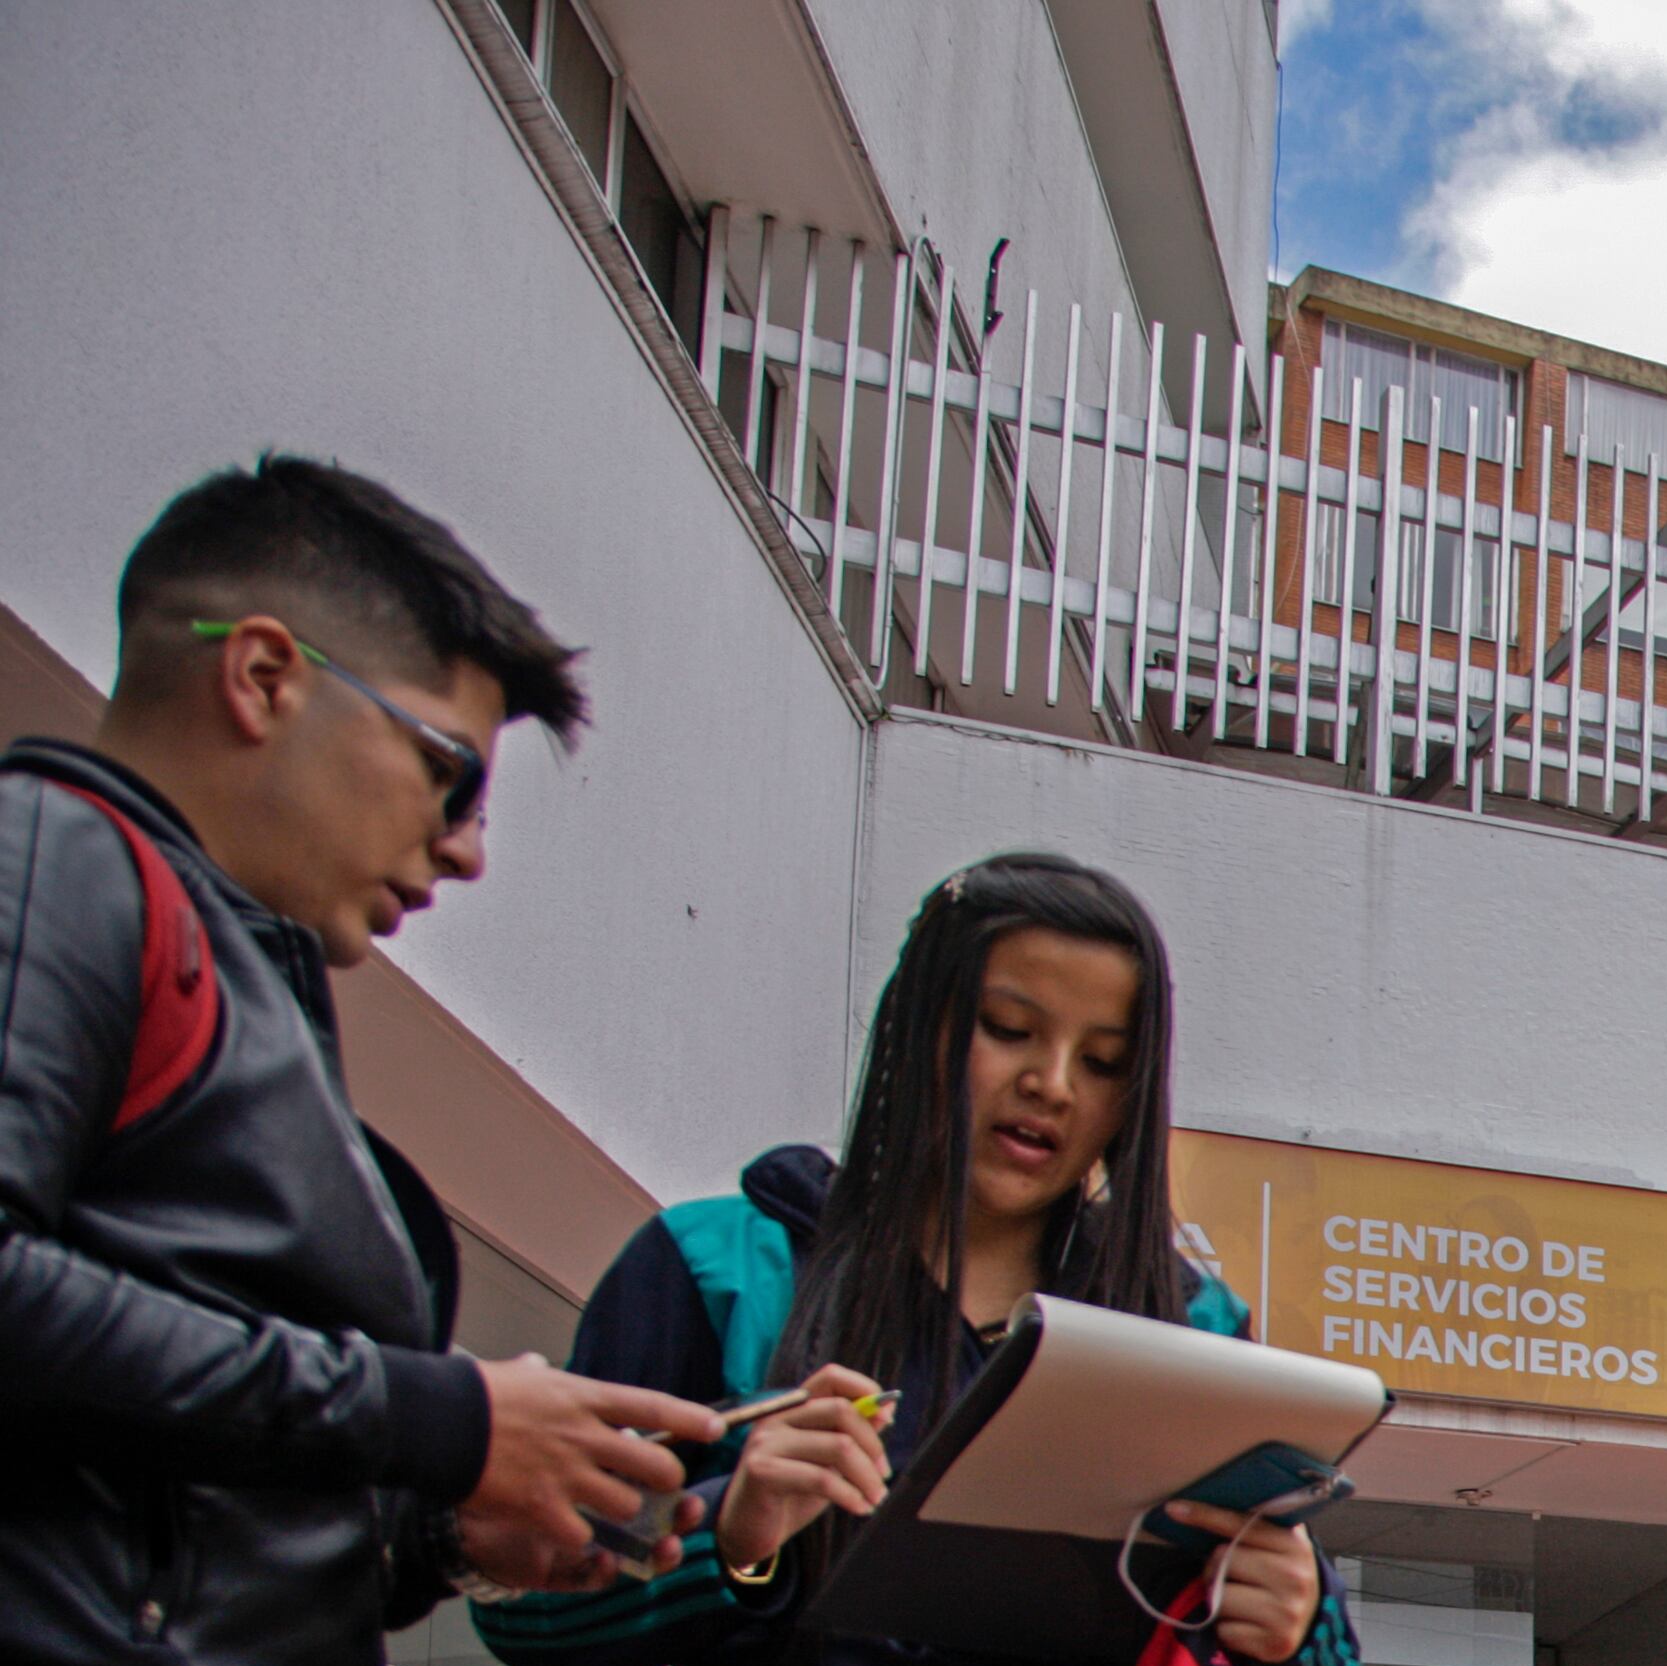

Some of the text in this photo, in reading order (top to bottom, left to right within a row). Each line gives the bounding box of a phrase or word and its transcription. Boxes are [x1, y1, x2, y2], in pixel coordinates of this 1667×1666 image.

[1323, 1215, 1605, 1283] CENTRO DE
[1323, 1265, 1587, 1329] SERVICIOS
[1323, 1314, 1659, 1386] FINANCIEROS
